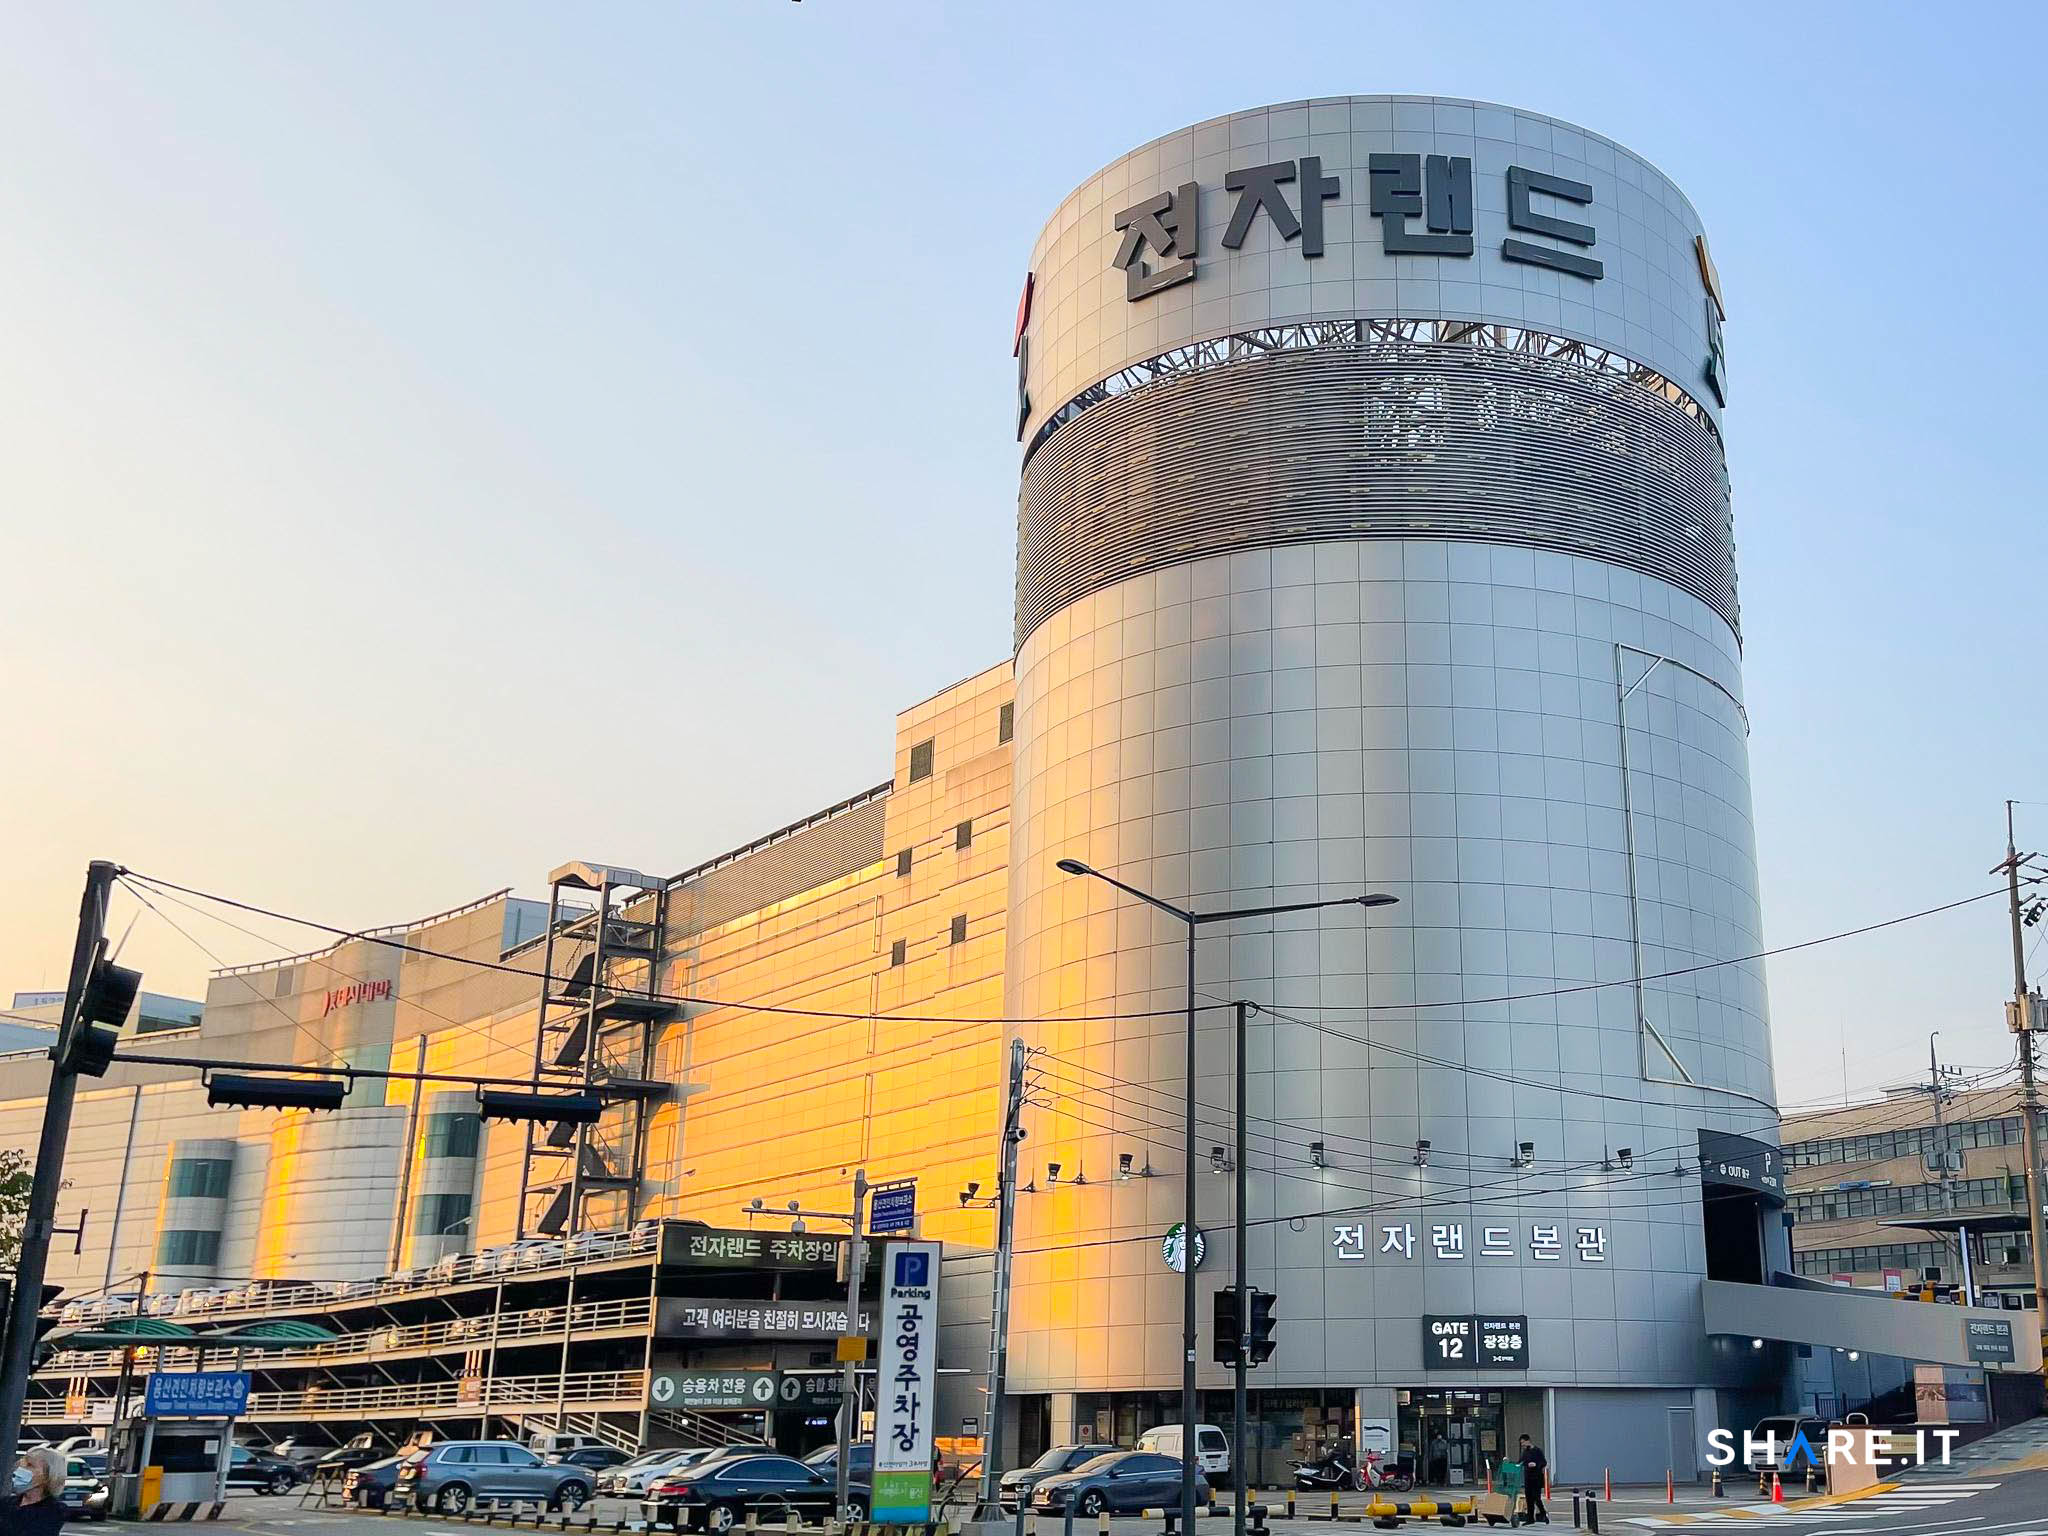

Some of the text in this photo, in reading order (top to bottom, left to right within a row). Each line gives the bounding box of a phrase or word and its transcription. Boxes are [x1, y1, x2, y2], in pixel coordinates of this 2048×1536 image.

[1112, 153, 1604, 302] 전자랜드
[1728, 1166, 1741, 1178] OUT
[690, 1236, 762, 1258] 전자랜드
[891, 1287, 930, 1300] Parking
[683, 1307, 870, 1332] 고객 여러분을 친절히 모시겠습다
[1431, 1321, 1469, 1335] GATE
[1439, 1337, 1463, 1358] 12
[1483, 1334, 1522, 1350] 광장층
[682, 1378, 746, 1394] 승용차 전용
[892, 1304, 922, 1452] 공영주차장
